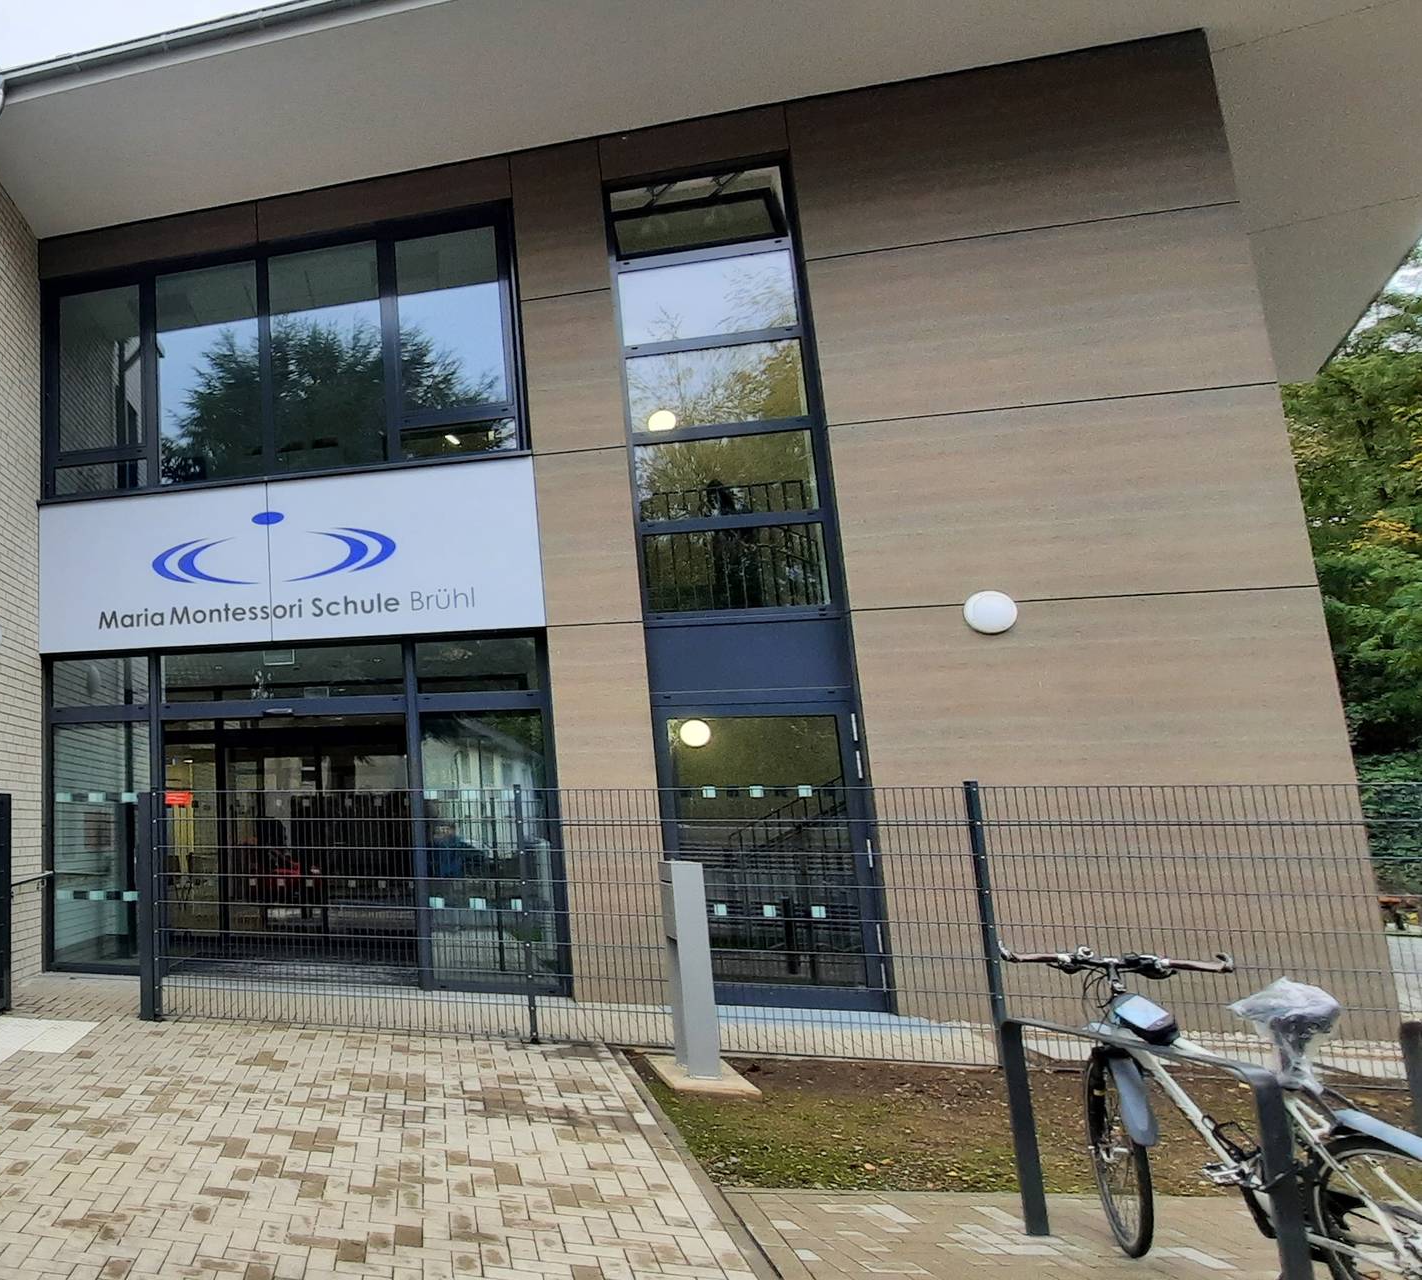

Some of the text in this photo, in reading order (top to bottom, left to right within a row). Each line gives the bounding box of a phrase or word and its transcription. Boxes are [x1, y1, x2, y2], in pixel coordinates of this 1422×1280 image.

[98, 586, 476, 630] Maria Montessori Schule Brühl
